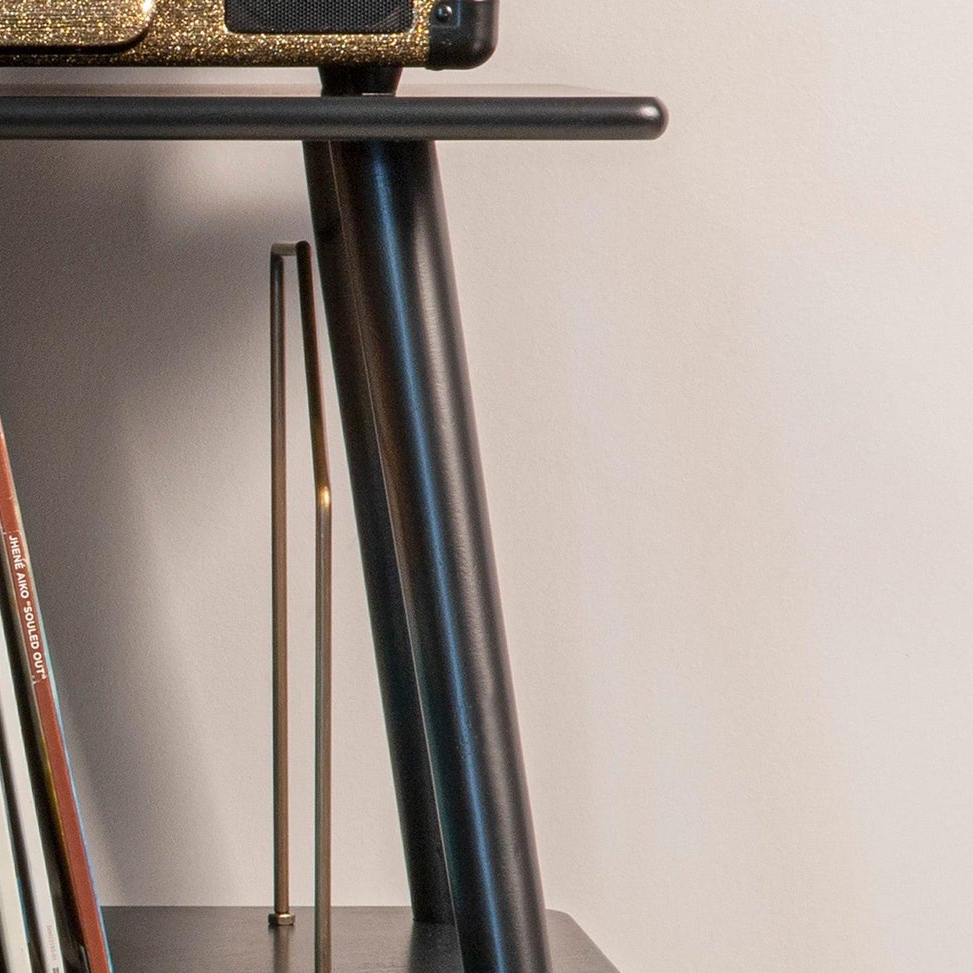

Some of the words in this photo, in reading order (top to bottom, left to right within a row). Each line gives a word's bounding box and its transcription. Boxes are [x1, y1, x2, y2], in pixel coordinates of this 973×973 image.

[10, 535, 25, 570] JHENÉ
[17, 573, 29, 599] AIKO
[23, 601, 40, 650] "SOULED
